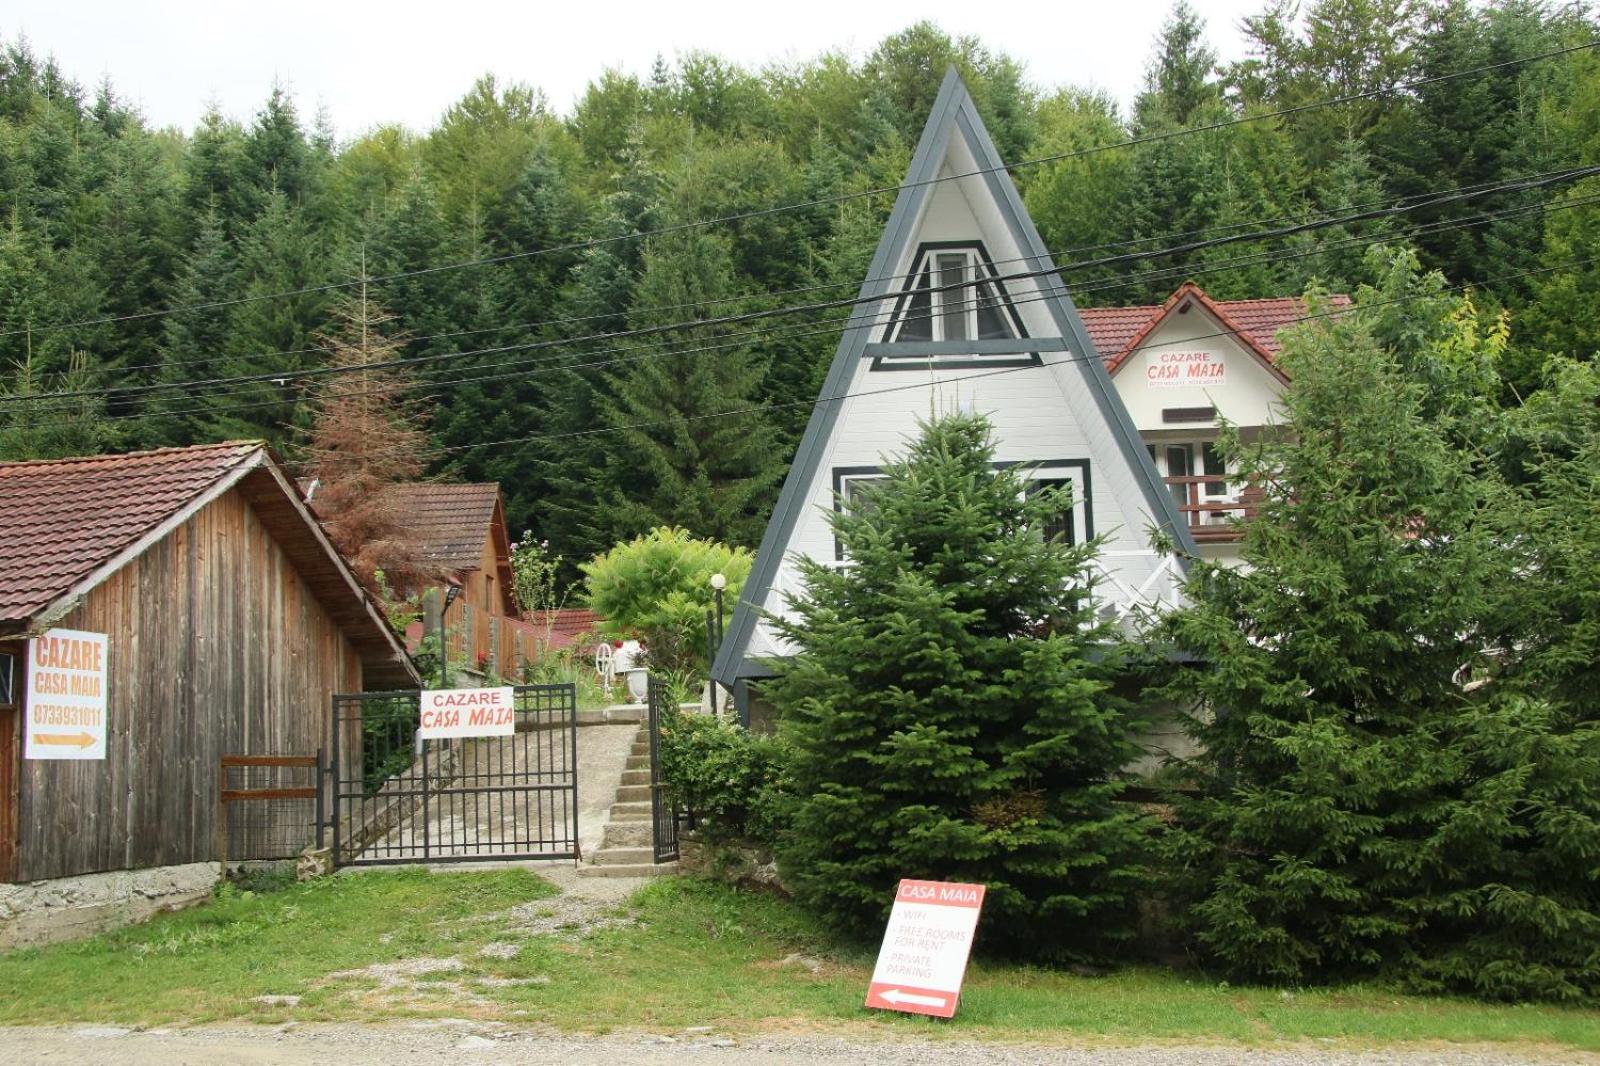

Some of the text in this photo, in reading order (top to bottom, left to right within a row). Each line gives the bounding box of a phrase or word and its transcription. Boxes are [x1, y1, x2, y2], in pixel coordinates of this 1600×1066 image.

[1161, 353, 1210, 362] CAZARE
[1148, 363, 1224, 379] CASA MAIA
[35, 636, 102, 672] CAZARE
[35, 672, 101, 697] CASA MAIA
[433, 692, 501, 707] CAZARE
[422, 707, 513, 728] CASA MAIA
[901, 885, 977, 902] CASA MAIA
[904, 910, 927, 920] WIFI
[899, 926, 967, 941] FREE ROOMS
[894, 937, 946, 952] FOR RENT
[890, 953, 932, 967] PRIVATE
[886, 964, 933, 978] PARKING
